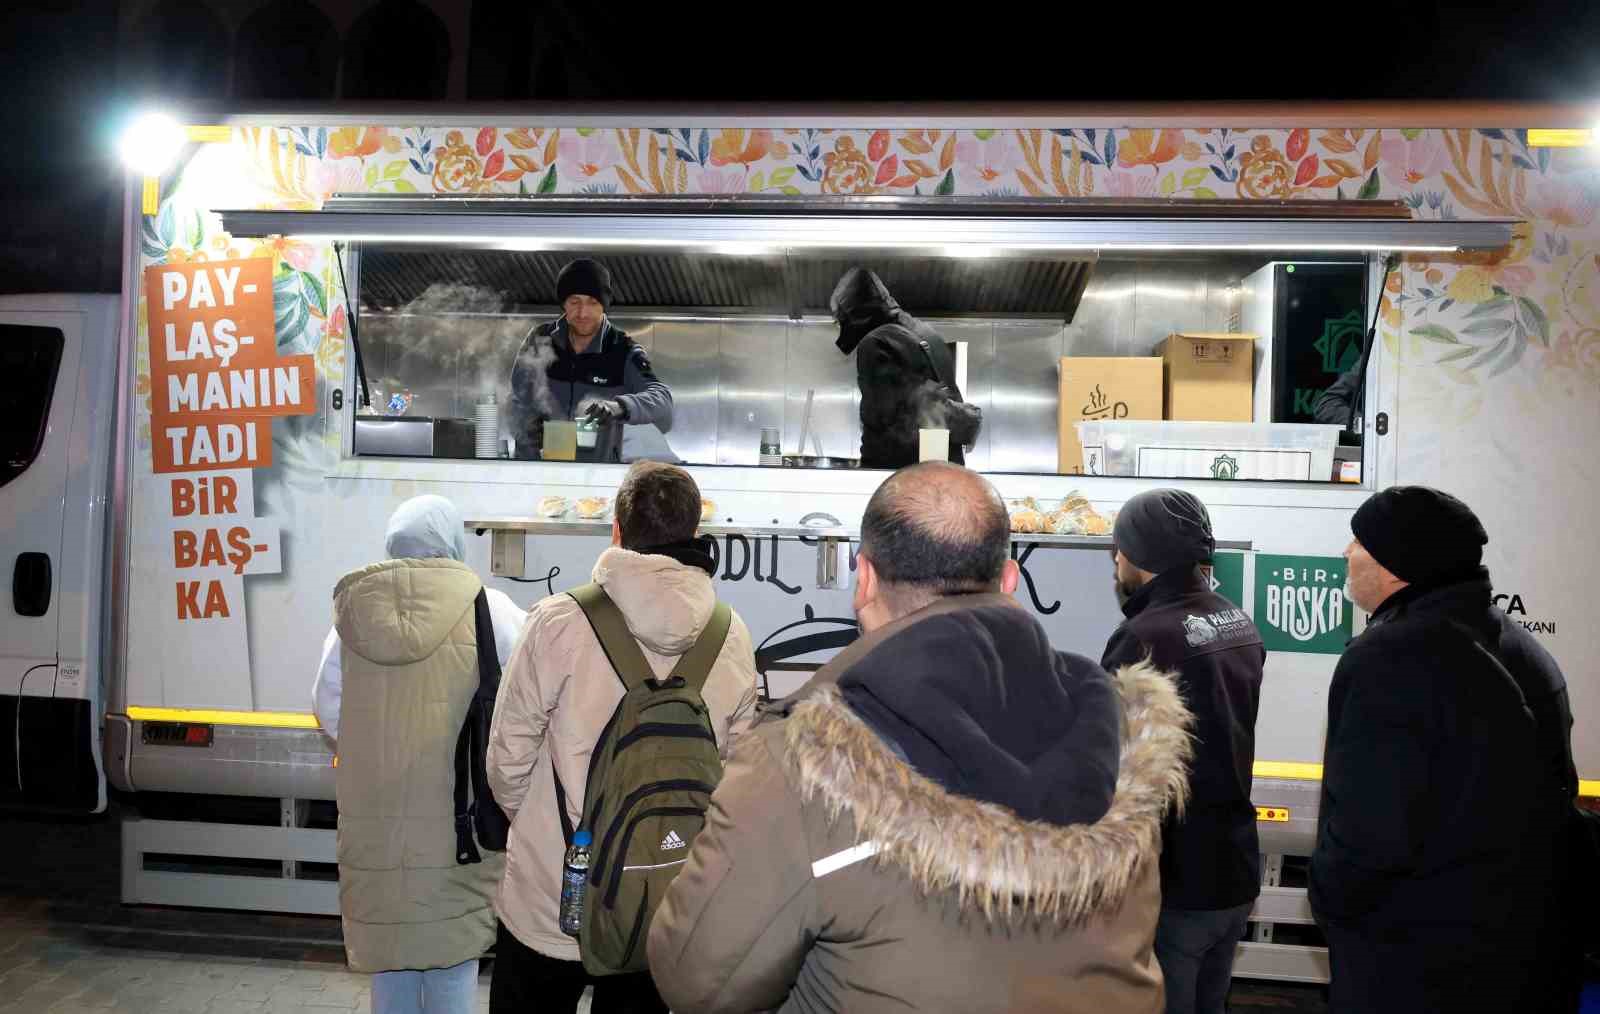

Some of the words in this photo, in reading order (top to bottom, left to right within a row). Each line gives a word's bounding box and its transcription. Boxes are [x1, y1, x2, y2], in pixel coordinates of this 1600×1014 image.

[162, 267, 258, 311] PAY-
[164, 318, 255, 368] LAŞ-
[168, 366, 301, 413] MANIN
[165, 422, 257, 466] TADI
[173, 526, 268, 575] BAŞ-
[176, 579, 231, 620] KA
[660, 841, 687, 851] adidas
